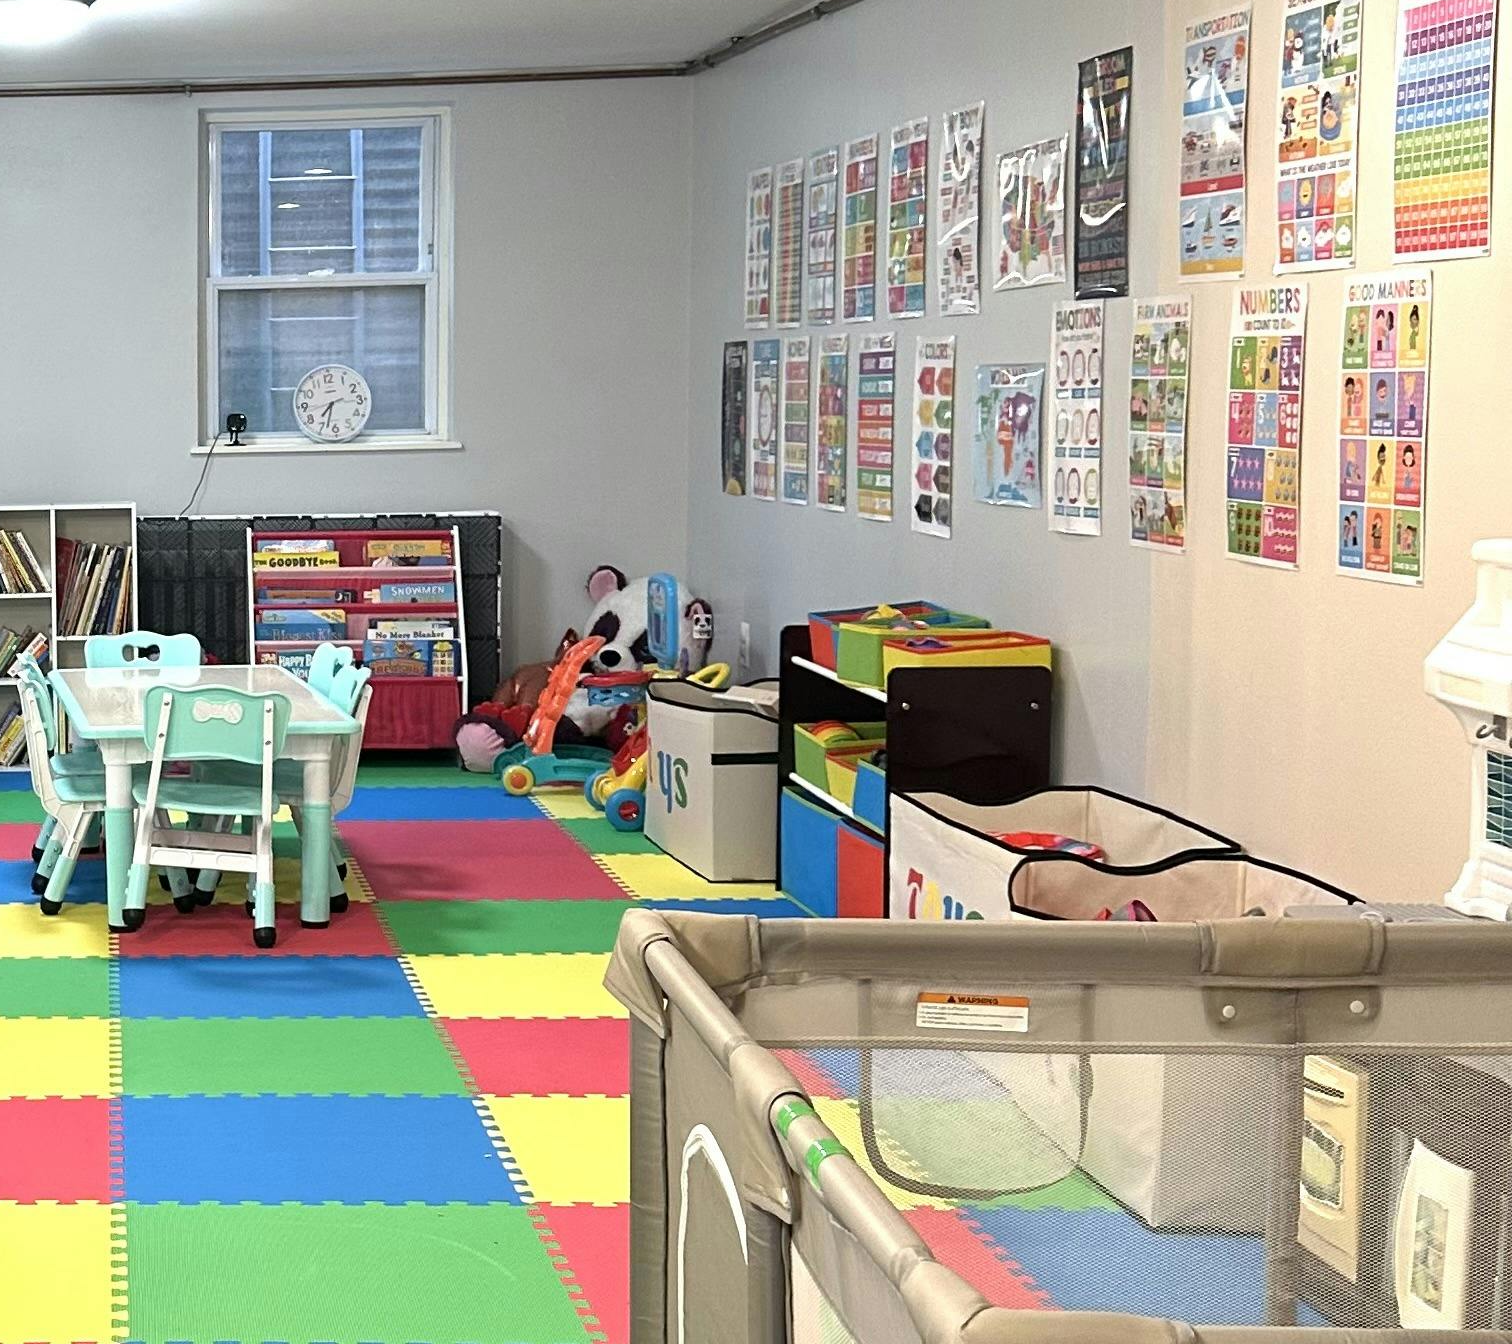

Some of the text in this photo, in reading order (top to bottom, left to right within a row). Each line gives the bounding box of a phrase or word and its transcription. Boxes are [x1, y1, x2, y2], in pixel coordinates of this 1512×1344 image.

[1349, 279, 1427, 302] GOOD MANNERS
[1240, 288, 1300, 315] NUMBERS
[1056, 306, 1101, 332] EMOTIONS
[1281, 347, 1289, 369] 3
[312, 378, 321, 389] 11
[323, 373, 334, 384] 12
[341, 375, 345, 386] 1
[302, 389, 314, 399] 10
[349, 383, 357, 394] 2
[356, 394, 364, 405] 3
[301, 402, 308, 412] 9
[352, 408, 360, 417] 4
[307, 414, 314, 424] 8
[345, 418, 352, 429] 5
[319, 422, 325, 434] 7
[331, 423, 340, 433] 6
[1230, 457, 1237, 477] 7
[269, 557, 318, 568] GOODBYE
[391, 585, 445, 597] SNOWMEN
[375, 631, 387, 639] No
[658, 750, 688, 814] ys
[958, 997, 999, 1006] WARNING
